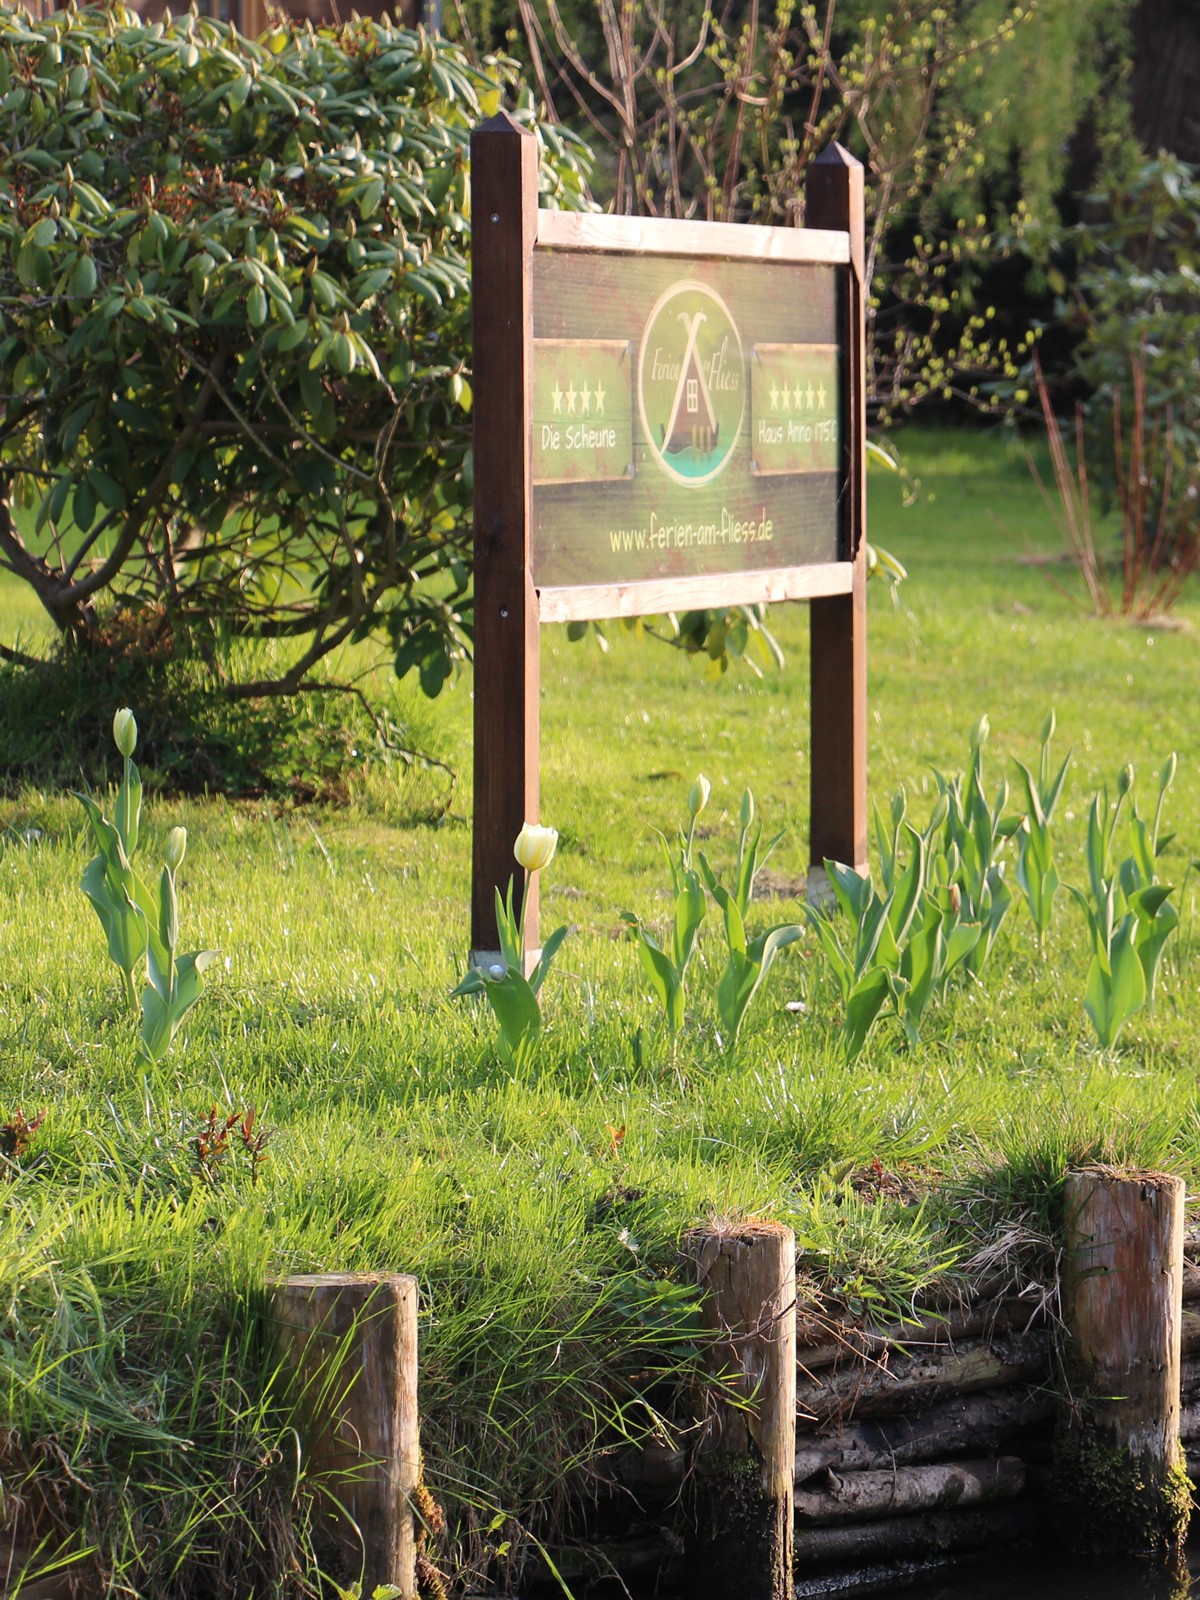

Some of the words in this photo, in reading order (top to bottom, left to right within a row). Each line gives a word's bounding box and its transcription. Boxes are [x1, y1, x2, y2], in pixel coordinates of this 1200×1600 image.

[651, 347, 680, 380] Ferien
[708, 335, 739, 390] Fliess
[541, 424, 560, 450] Die
[565, 423, 616, 450] Scheune
[758, 418, 783, 444] Haus
[786, 419, 811, 443] Anno
[609, 506, 774, 552] www.ferien-am-fliess.de
